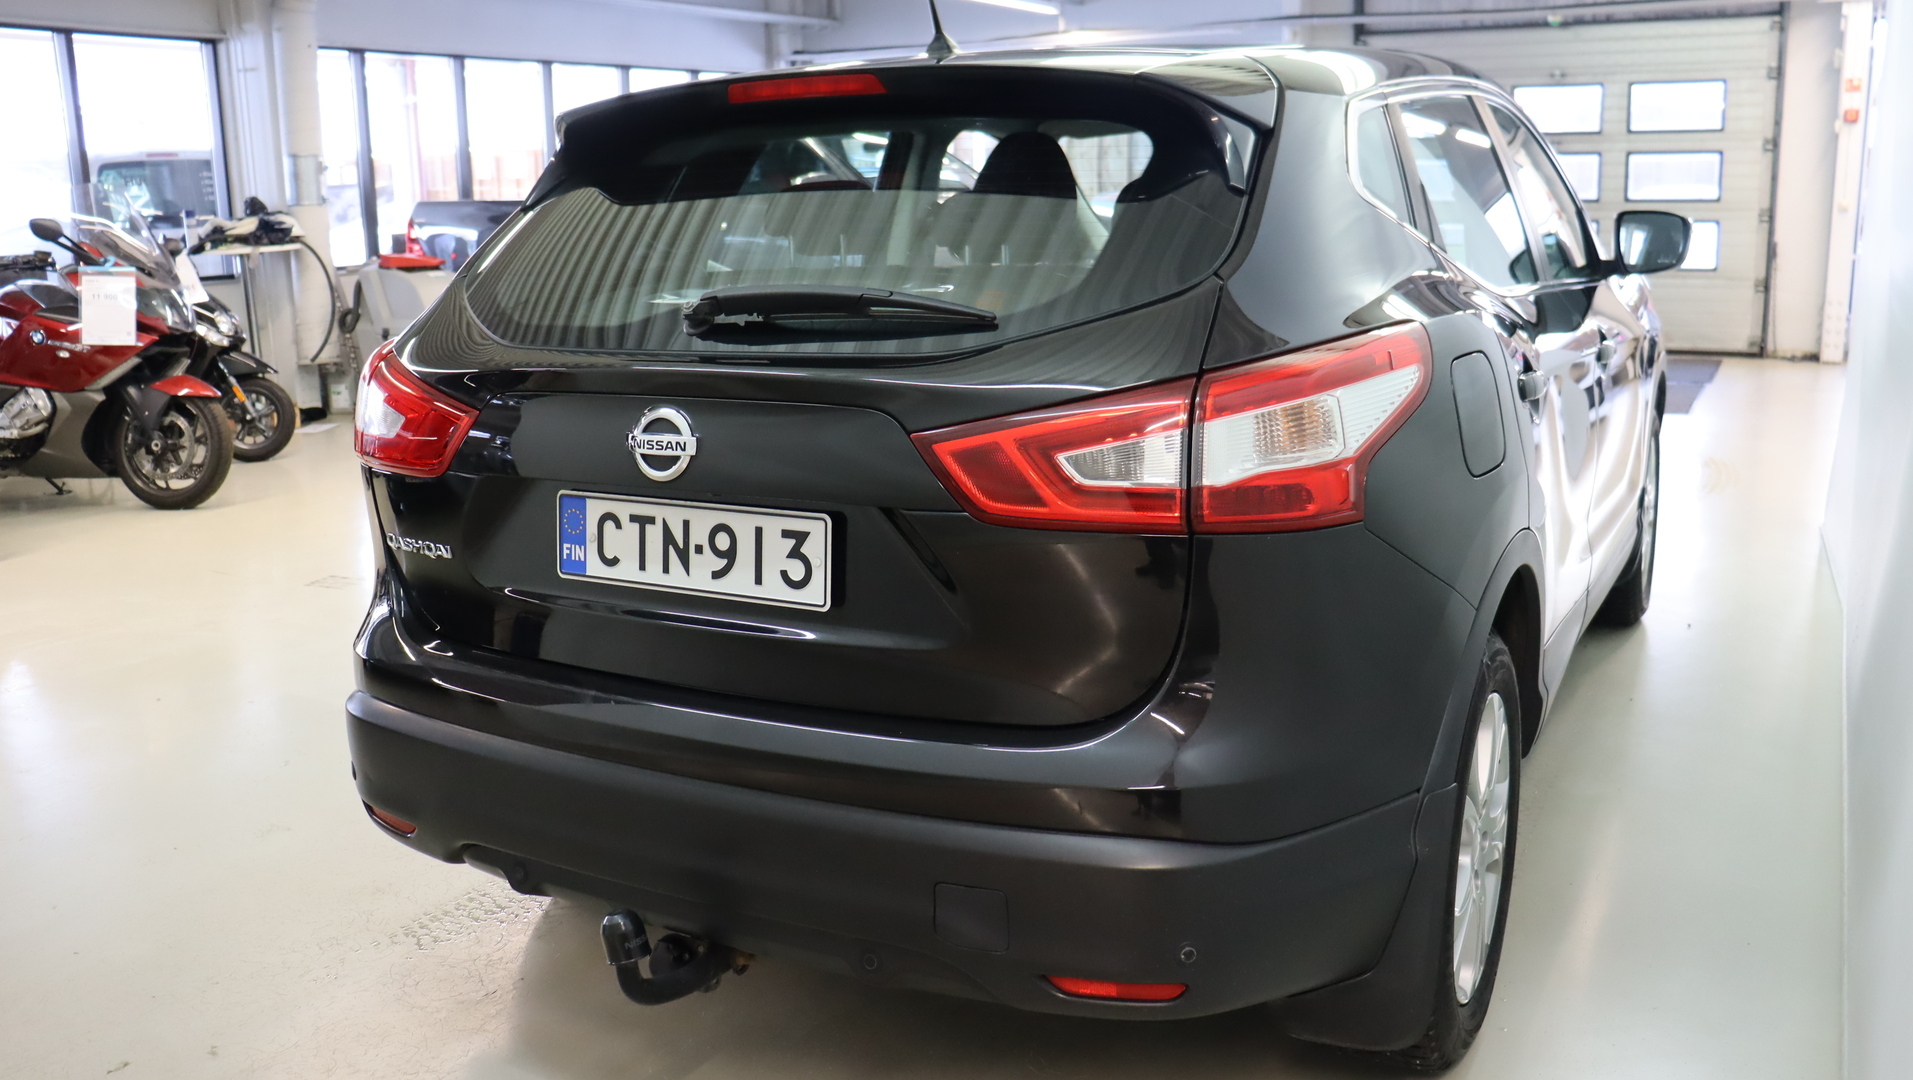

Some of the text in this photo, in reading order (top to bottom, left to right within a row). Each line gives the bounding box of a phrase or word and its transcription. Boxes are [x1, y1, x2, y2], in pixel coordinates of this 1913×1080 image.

[633, 438, 687, 452] NISSAN
[386, 532, 453, 559] QASHQAI
[562, 542, 585, 562] FIN
[596, 511, 813, 590] CTN-913
[624, 934, 647, 950] NISS
